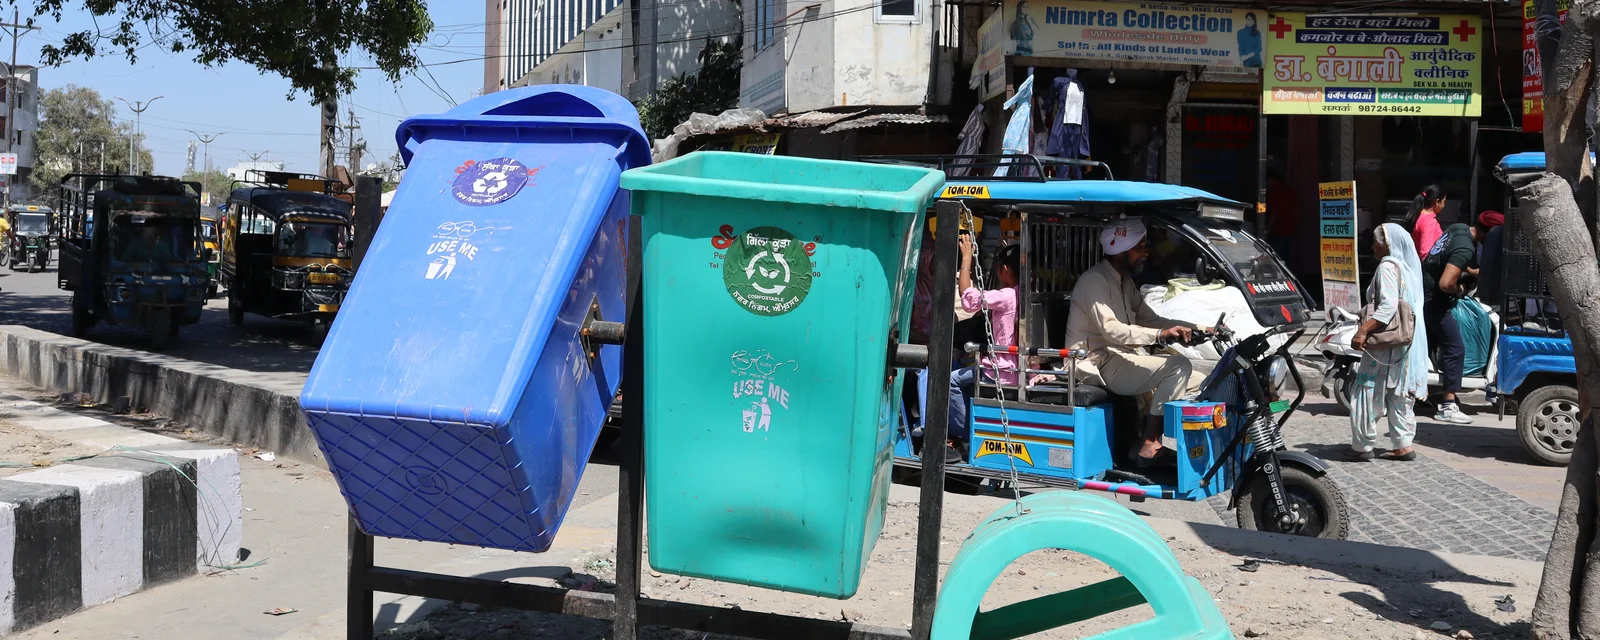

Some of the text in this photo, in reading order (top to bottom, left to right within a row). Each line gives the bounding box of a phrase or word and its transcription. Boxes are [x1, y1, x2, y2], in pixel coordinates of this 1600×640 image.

[1045, 6, 1233, 33] Nimrta Collection
[1312, 18, 1330, 27] हर
[1365, 17, 1393, 28] यहां
[1394, 17, 1432, 28] मिलो
[1088, 29, 1200, 44] Wholesale Only
[1412, 33, 1444, 44] मिलो
[1096, 43, 1112, 51] All
[1114, 43, 1145, 52] Kinds
[1148, 45, 1159, 53] of
[1161, 46, 1198, 55] Ladies
[1200, 48, 1231, 56] Wear
[1273, 45, 1405, 83] डा. बंगाली
[1414, 65, 1470, 79] क्लीनिक
[1358, 105, 1422, 113] 98724-86442
[947, 186, 984, 195] TOM-TOM
[426, 240, 479, 262] USE ME
[747, 293, 785, 303] COMPOSTABLE
[732, 379, 790, 411] USE ME
[985, 440, 1022, 455] TOM-TOM
